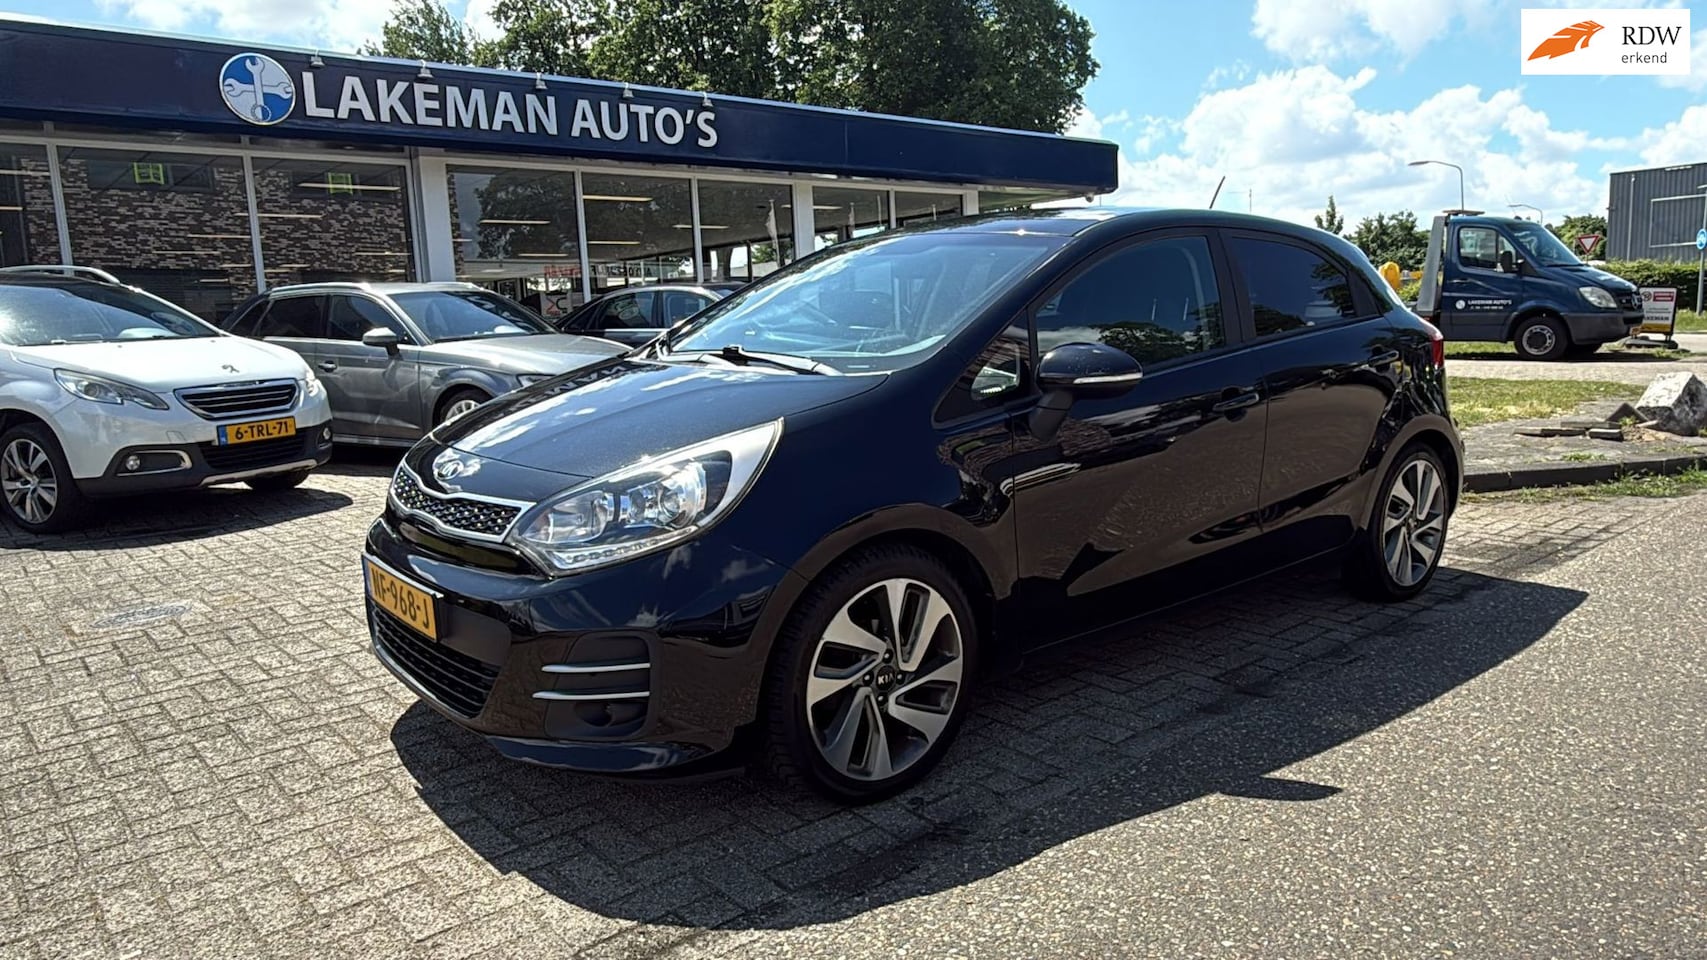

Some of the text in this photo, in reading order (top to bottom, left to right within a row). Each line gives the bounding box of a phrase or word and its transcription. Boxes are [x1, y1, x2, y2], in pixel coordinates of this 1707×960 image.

[301, 70, 718, 148] LAKEMAN AUTO'S
[235, 420, 289, 440] 6-TRL-71
[371, 567, 429, 629] NF-968-J
